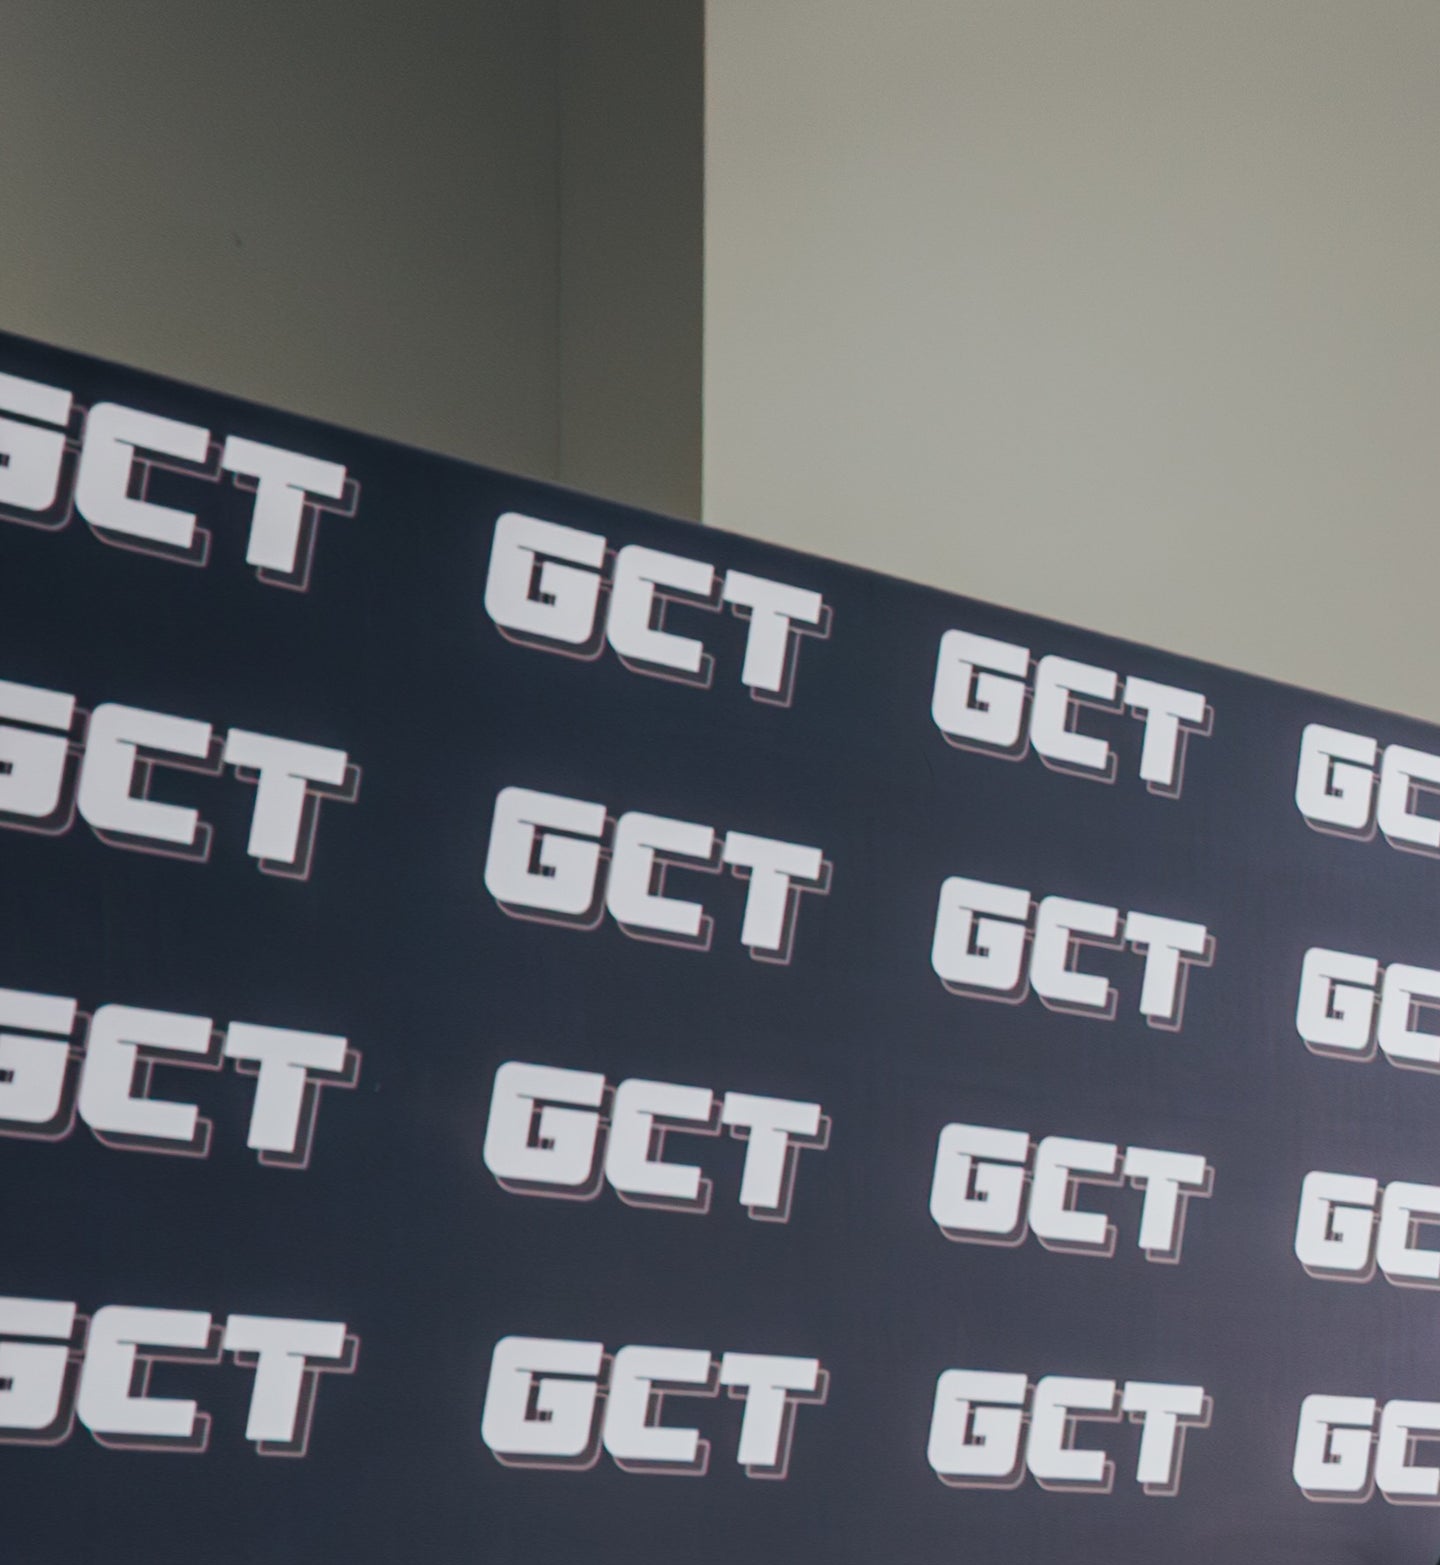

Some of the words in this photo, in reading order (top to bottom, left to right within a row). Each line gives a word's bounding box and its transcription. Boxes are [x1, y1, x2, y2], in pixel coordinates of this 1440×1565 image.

[485, 512, 823, 691] GCT
[932, 629, 1206, 785] GCT
[485, 787, 822, 950] GCT
[932, 877, 1207, 1018] GCT
[484, 1062, 824, 1208] GCT
[930, 1124, 1208, 1250] GCT
[482, 1337, 820, 1465] GCT
[928, 1370, 1206, 1483] GCT
